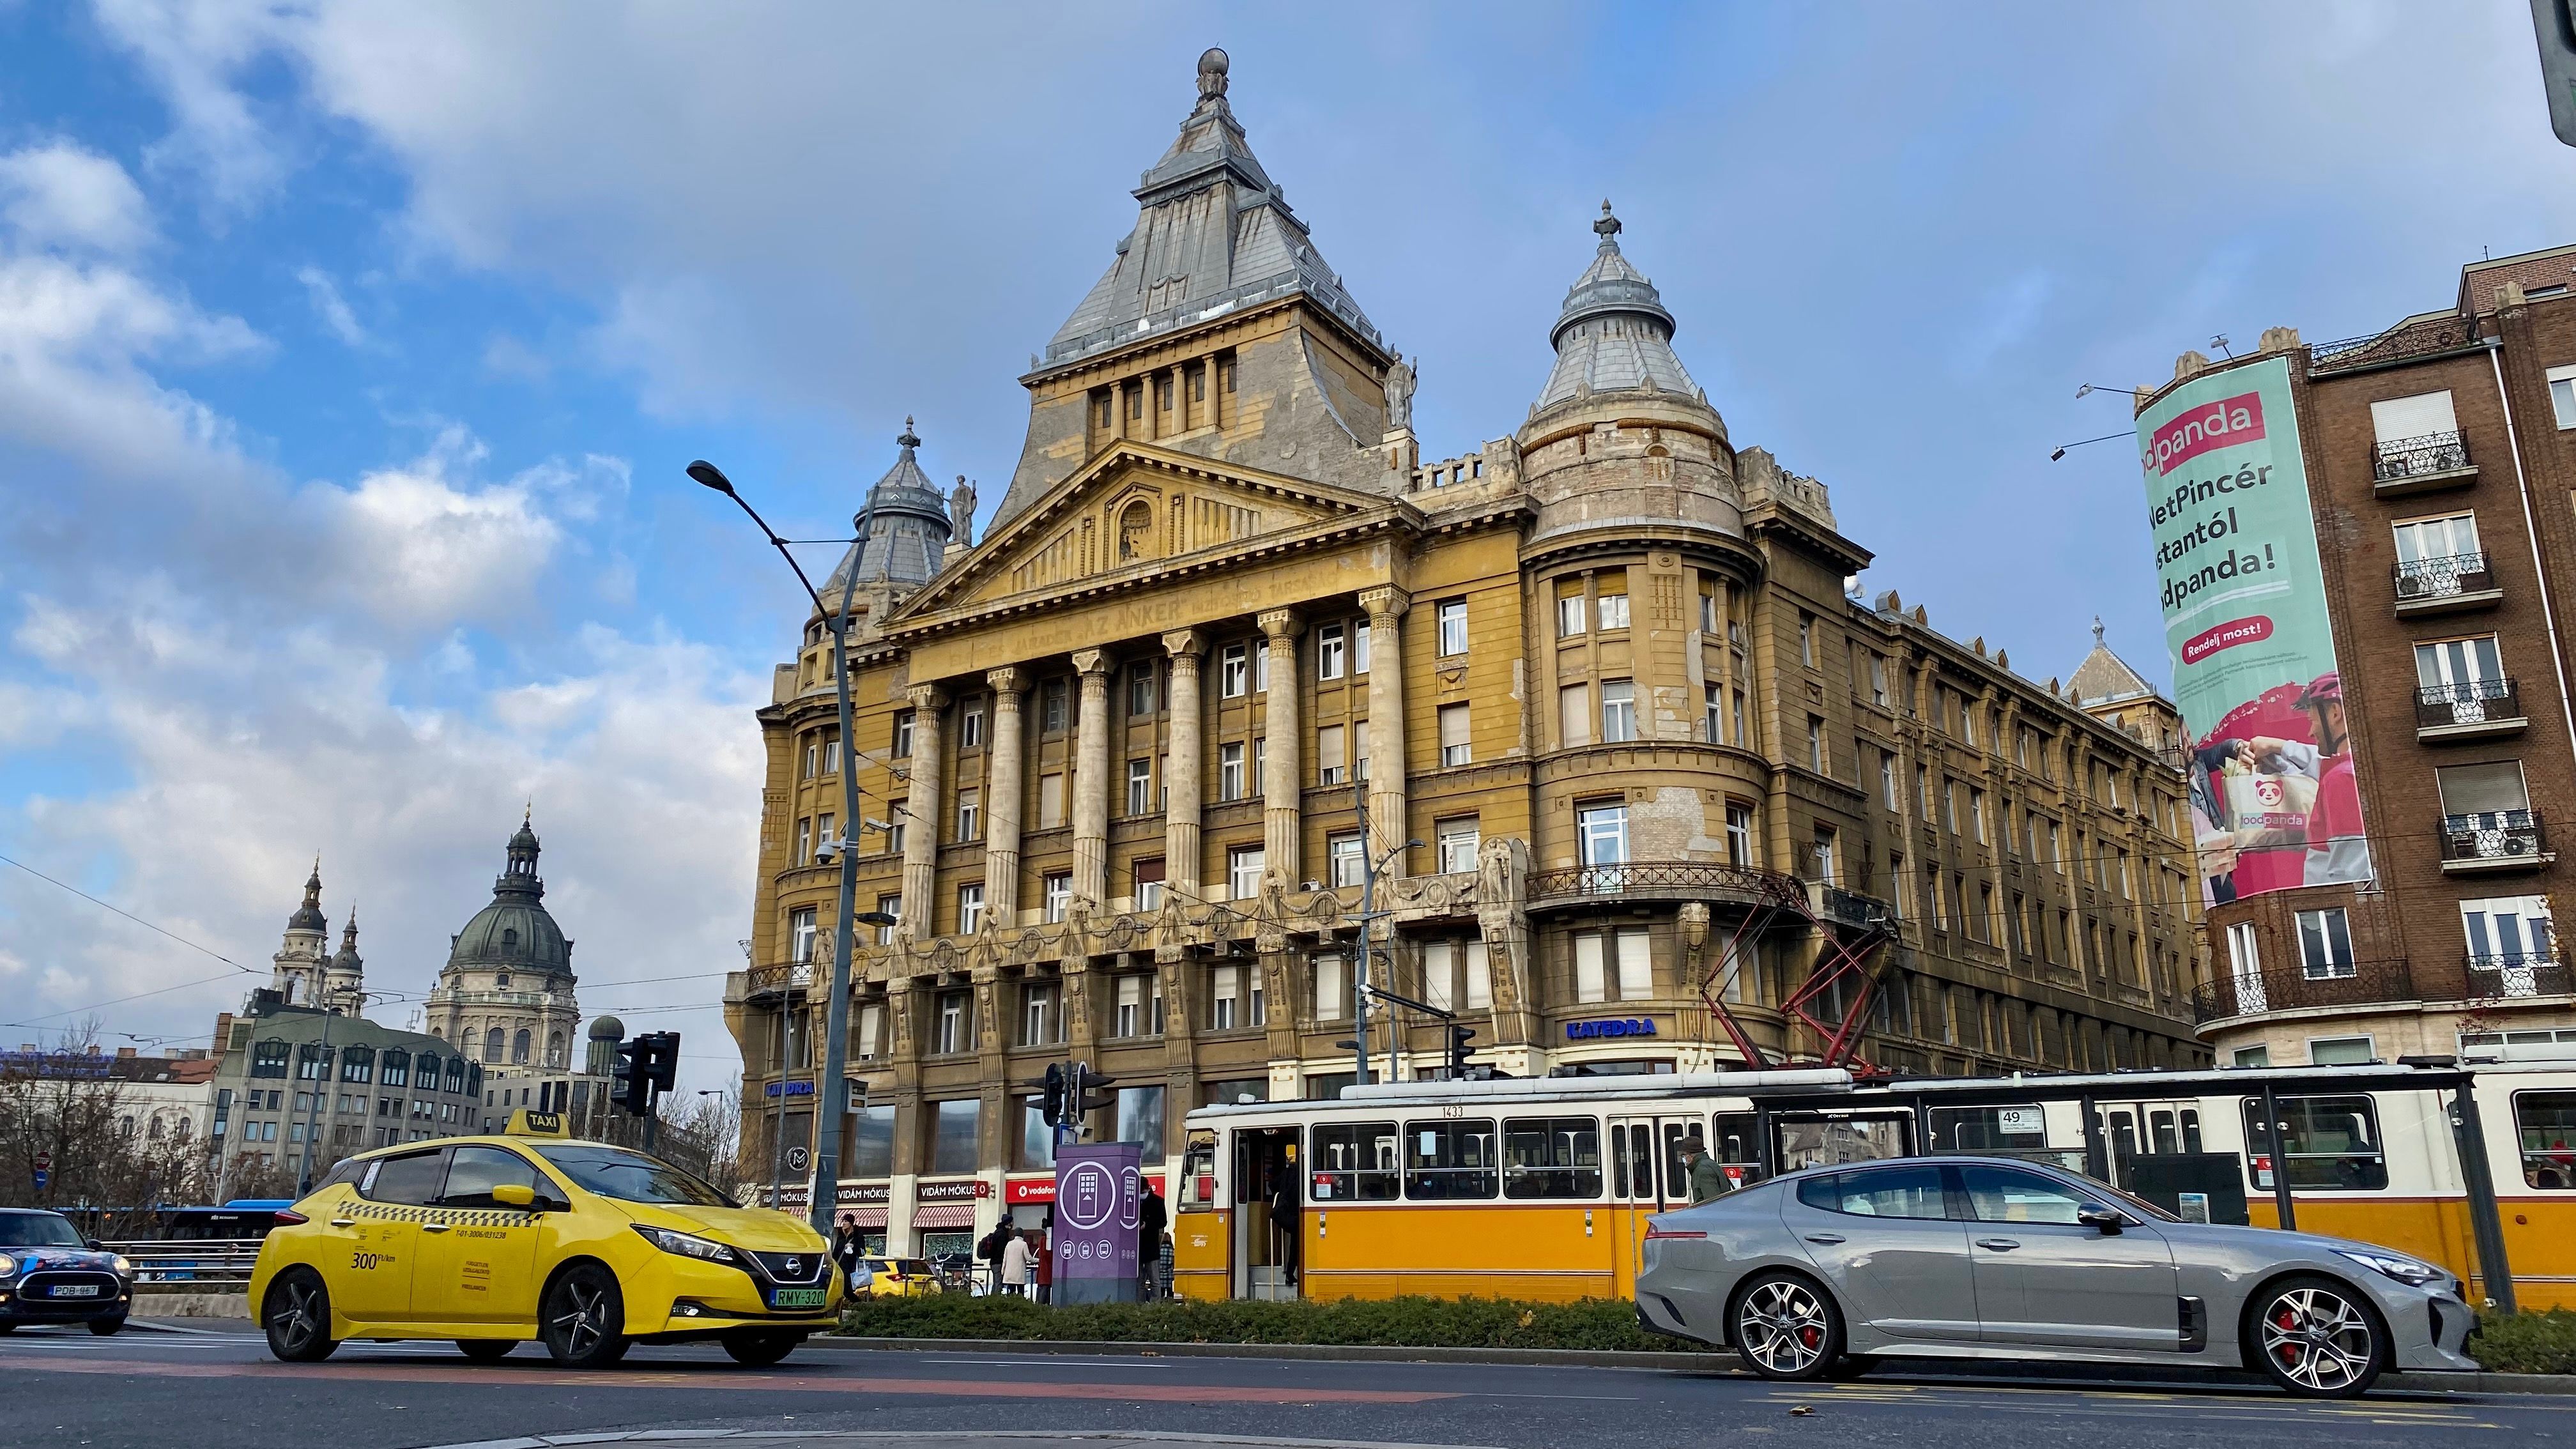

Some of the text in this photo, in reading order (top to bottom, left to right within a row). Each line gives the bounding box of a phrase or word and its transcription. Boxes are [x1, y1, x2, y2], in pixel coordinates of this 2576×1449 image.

[2142, 403, 2252, 478] dpanda
[2156, 507, 2238, 571] stantól
[2161, 544, 2275, 612] dpanda!
[2188, 623, 2262, 657] Rendelj most!
[1567, 1018, 1657, 1038] KATEDRA
[767, 1082, 813, 1096] KATDRA
[1443, 1106, 1462, 1117] 1433
[2004, 1112, 2020, 1123] 49
[530, 1114, 556, 1127] TAXI
[780, 1191, 808, 1202] MÓKUS
[838, 1187, 890, 1199] VIDÁM MÓKUS
[921, 1184, 976, 1197] VIDÁM MÓKUS
[351, 1252, 377, 1270] 300
[778, 1291, 824, 1305] RMY-320
